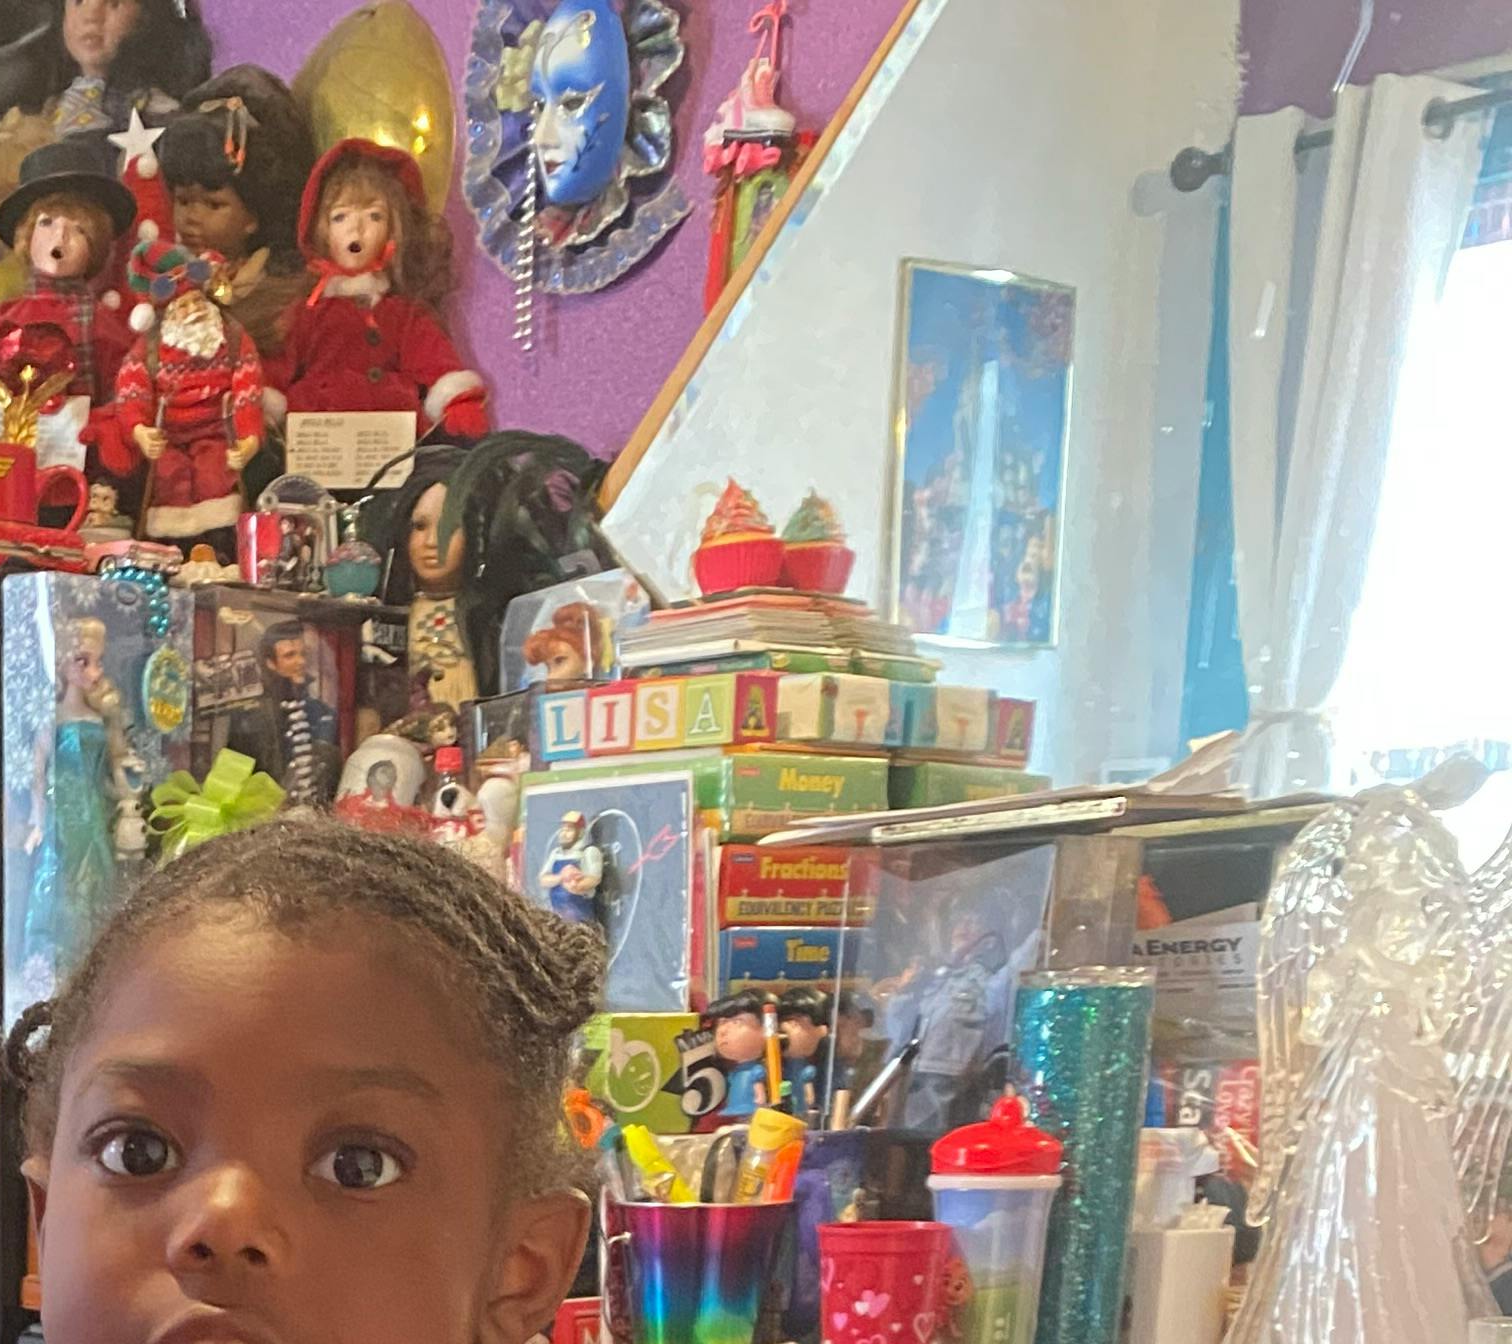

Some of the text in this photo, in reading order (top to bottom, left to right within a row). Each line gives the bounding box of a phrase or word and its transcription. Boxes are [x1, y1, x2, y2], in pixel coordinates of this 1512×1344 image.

[550, 686, 722, 747] LISA
[777, 767, 846, 799] Money
[759, 855, 849, 881] Fractions
[785, 938, 831, 963] Time
